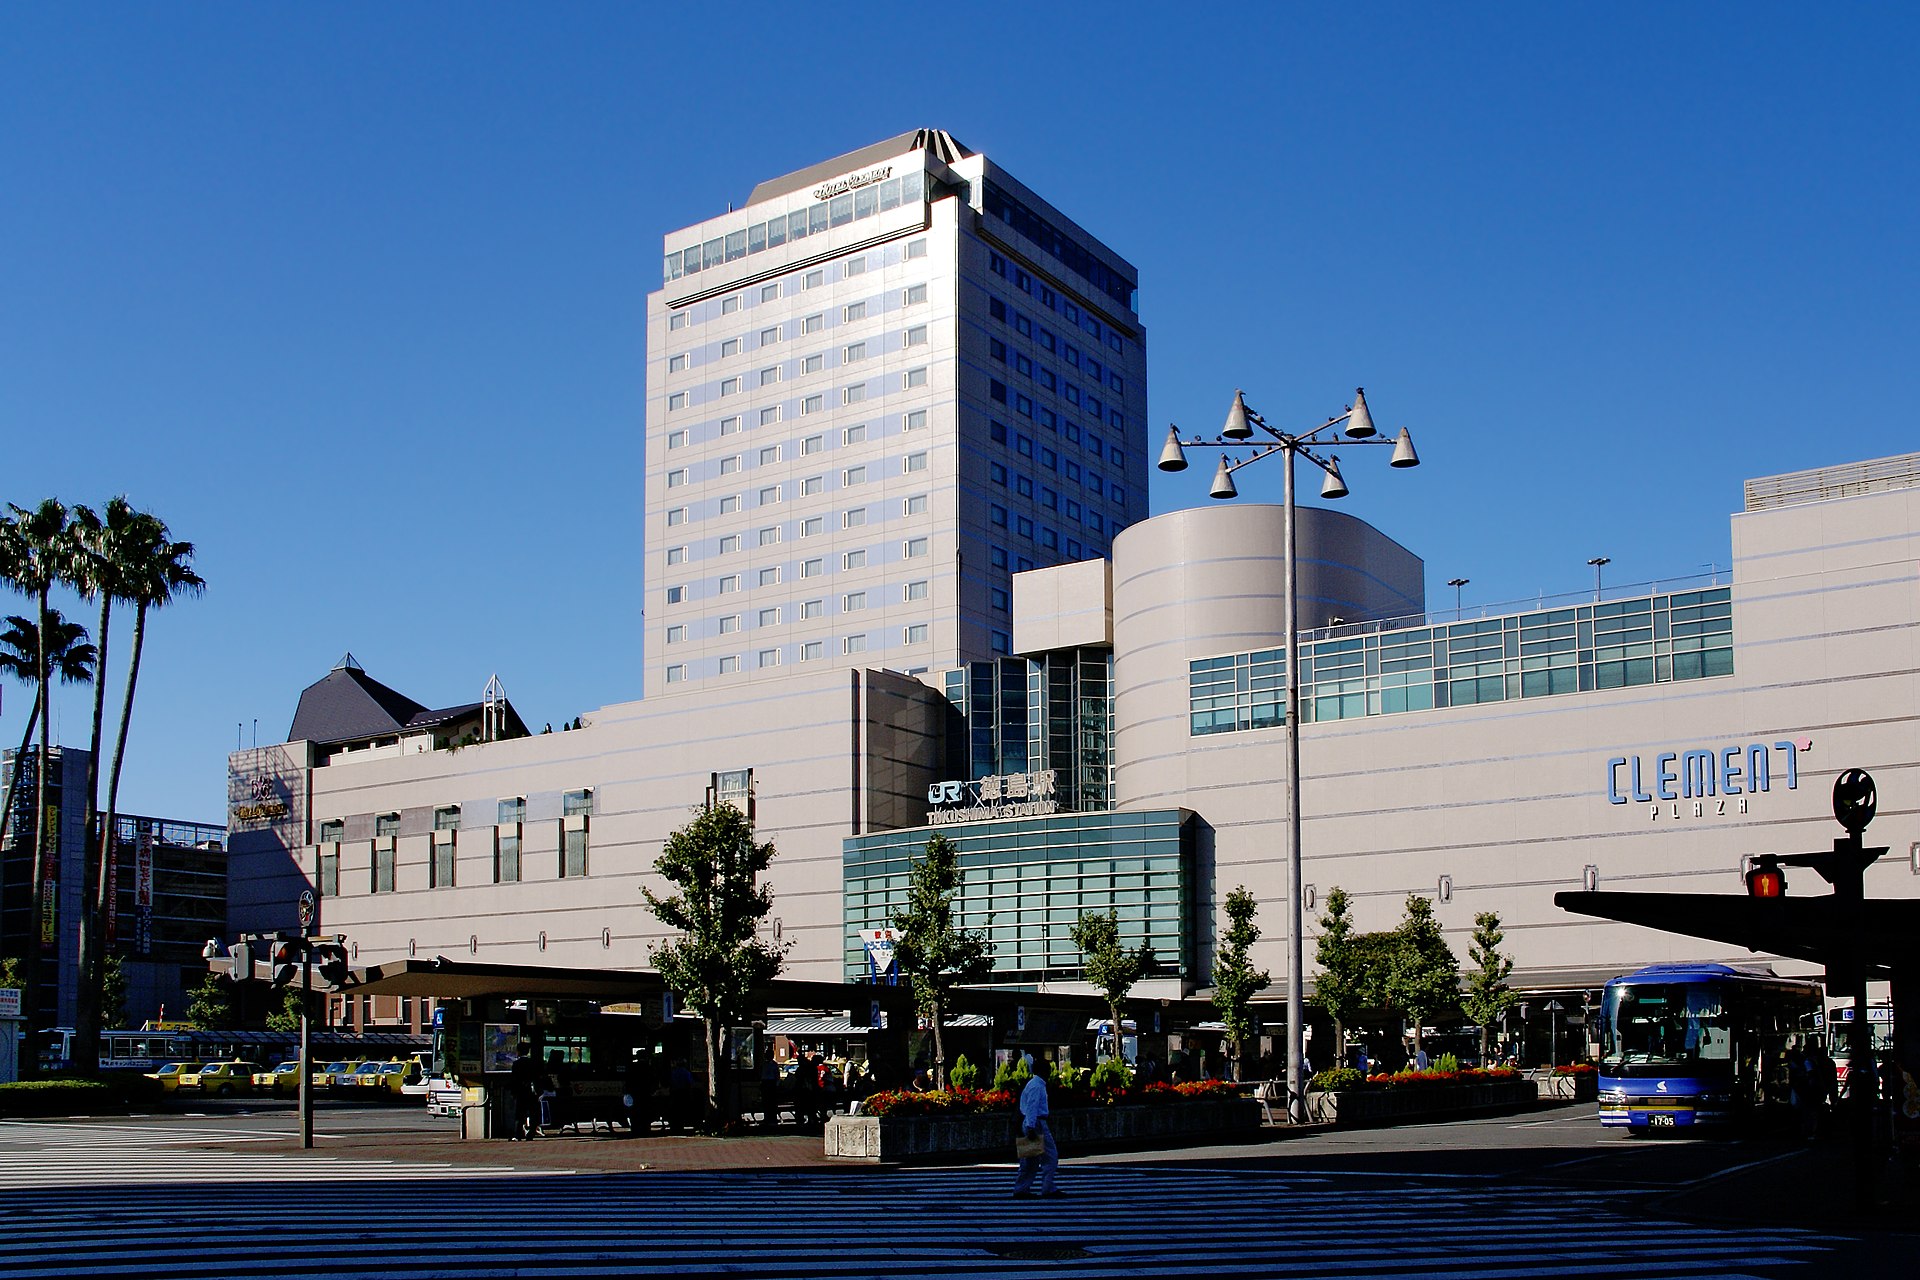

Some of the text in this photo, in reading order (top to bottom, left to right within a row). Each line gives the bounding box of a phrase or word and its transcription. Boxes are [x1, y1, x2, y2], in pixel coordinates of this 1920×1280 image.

[1607, 740, 1798, 804] CLEMENT
[928, 769, 1056, 804] JR 徳島駅
[926, 800, 1056, 825] TOKUSHIMA STATION
[1650, 797, 1748, 820] PLAZA
[871, 1004, 879, 1022] 2
[1018, 1008, 1024, 1026] 3
